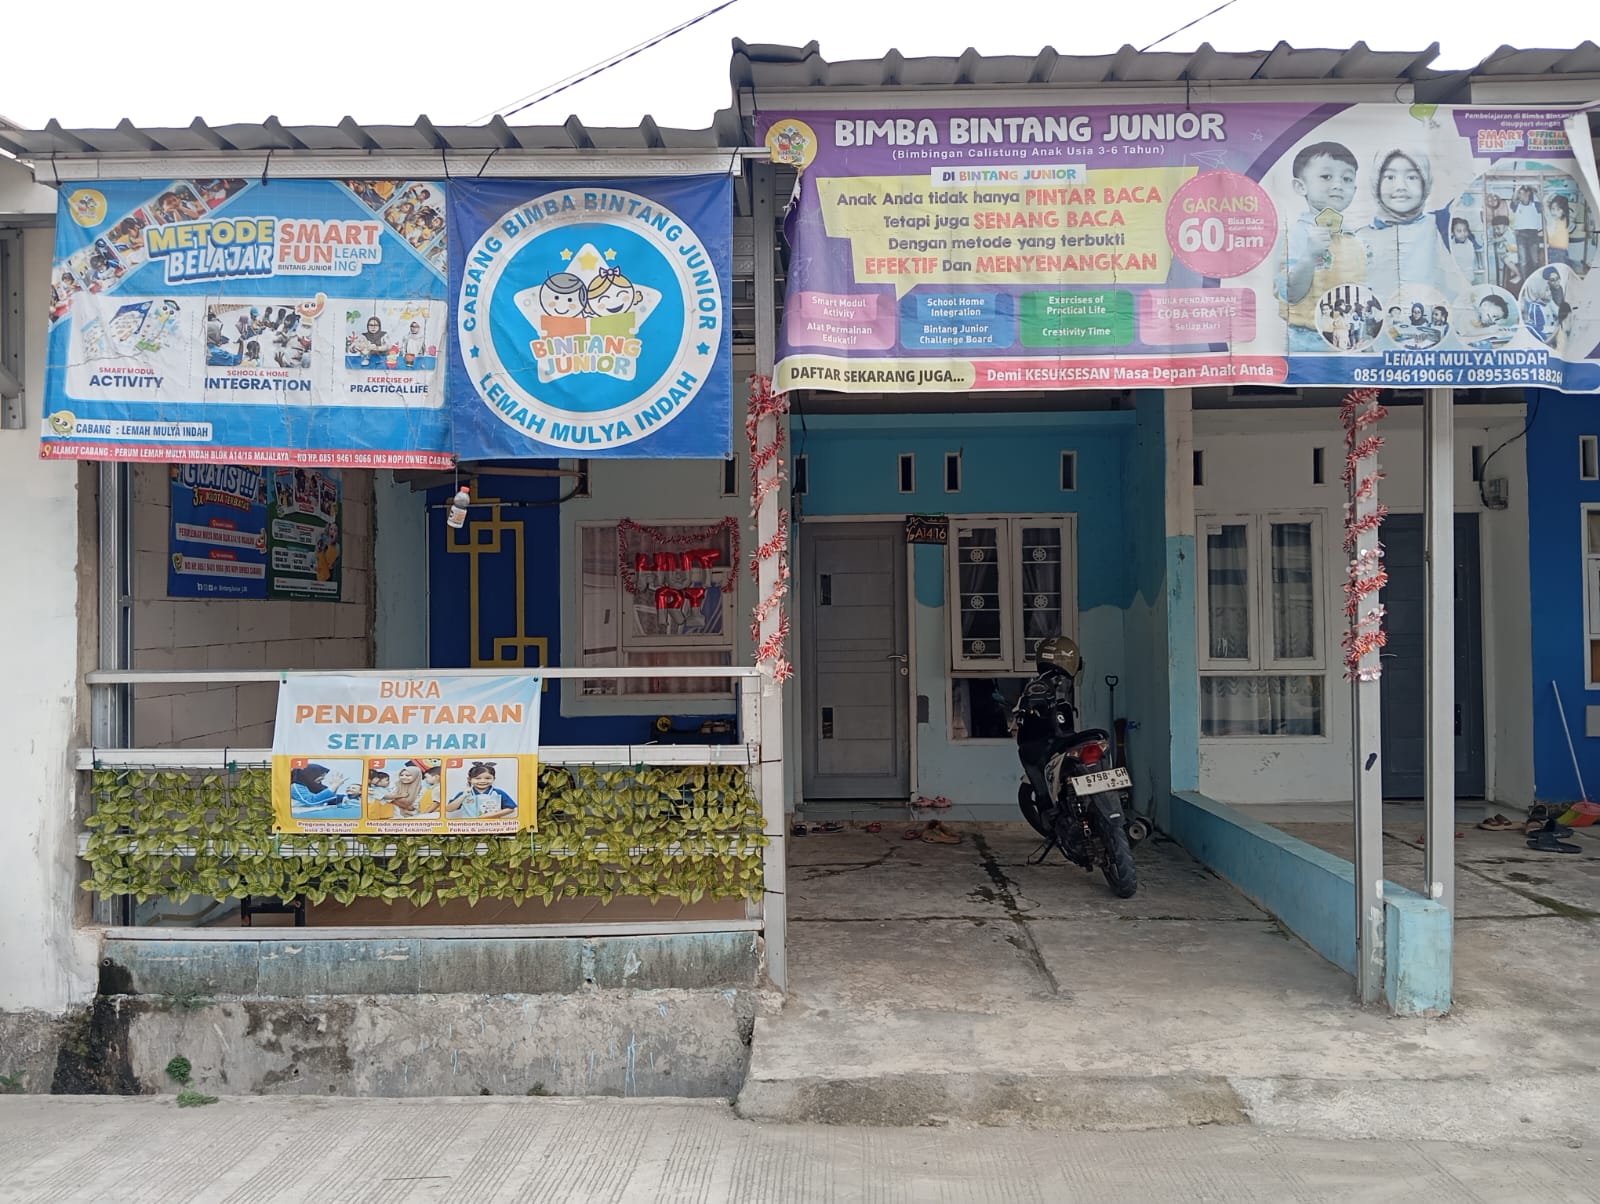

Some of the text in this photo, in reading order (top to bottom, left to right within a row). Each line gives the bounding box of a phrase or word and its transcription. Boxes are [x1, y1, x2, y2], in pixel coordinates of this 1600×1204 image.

[835, 111, 1225, 147] BIMBA BINTANG JUNIOR
[1478, 130, 1523, 140] SMART
[1478, 140, 1504, 148] FUN
[892, 144, 1165, 160] (Bimbingan Calistung Anak Usia 3-6 Tahun)
[942, 168, 1077, 181] DI BINTANG JUNIOR
[836, 186, 1162, 206] Anak Anda tidak hanya PINTAR BACA
[1182, 196, 1259, 214] GARANSI
[883, 209, 1125, 229] Tetapi juga SENANG BACA
[148, 221, 273, 256] METODE
[279, 222, 379, 245] SMART
[1178, 217, 1225, 253] 60
[888, 233, 1125, 252] Dengan metode yang terbukti
[279, 245, 334, 264] FUN
[334, 246, 377, 260] LEARN
[169, 244, 272, 279] BELAJAR
[307, 264, 332, 272] JUNIOR
[334, 260, 358, 272] ING
[463, 193, 717, 333] CABANG BIMBA BINTANG JUNIOR
[865, 253, 1158, 274] EFEKTIF Dan MENYENANGKAN
[811, 295, 866, 307] Smart Modul
[927, 297, 985, 306] School Home
[1048, 295, 1104, 305] Exercises of
[823, 307, 855, 319] Activity
[931, 308, 981, 318] Integration
[1046, 305, 1106, 316] Practical Life
[1192, 307, 1236, 319] GRATIS
[807, 321, 872, 335] Alat Permainan
[923, 323, 989, 335] Bintang Junior
[1042, 326, 1111, 338] Creativity Time
[822, 334, 857, 344] Edukatif
[920, 334, 993, 346] Challenge Board
[531, 335, 642, 360] BINTANG
[544, 356, 632, 375] JUNIOR
[1384, 352, 1548, 366] LEMAH MULYA INDAH
[99, 367, 155, 375] SMART MODUL
[226, 369, 259, 377] SCHOOL
[266, 370, 289, 378] HOME
[791, 366, 965, 385] DAFTAR SEKARANG JUGA...
[987, 363, 1273, 382] Demi KESUKSESAN Masa Depan Anak Anda
[1353, 367, 1454, 382] 085194619066
[1456, 368, 1463, 382] /
[89, 375, 164, 388] ACTIVITY
[204, 377, 311, 391] INTEGRATION
[367, 376, 402, 384] EXERCISE
[350, 384, 429, 394] PRACTICAL LIFE
[478, 371, 699, 444] LEMAH MULYA INDAH
[76, 423, 208, 437] CABANG LEMAH MULYA INDAH
[52, 447, 80, 455] ALAMAT
[80, 447, 109, 456] CABANG
[114, 448, 139, 457] PERUM
[140, 449, 164, 458] LEMAH
[165, 449, 187, 459] MULYA
[188, 450, 209, 459] INDAH
[210, 451, 229, 460] BLOK
[254, 452, 289, 462] MAJALAYA
[404, 455, 428, 465] OWNER
[380, 680, 441, 699] BUKA
[295, 703, 522, 724] PENDAFTARAN
[327, 732, 487, 750] SETIAP HARI
